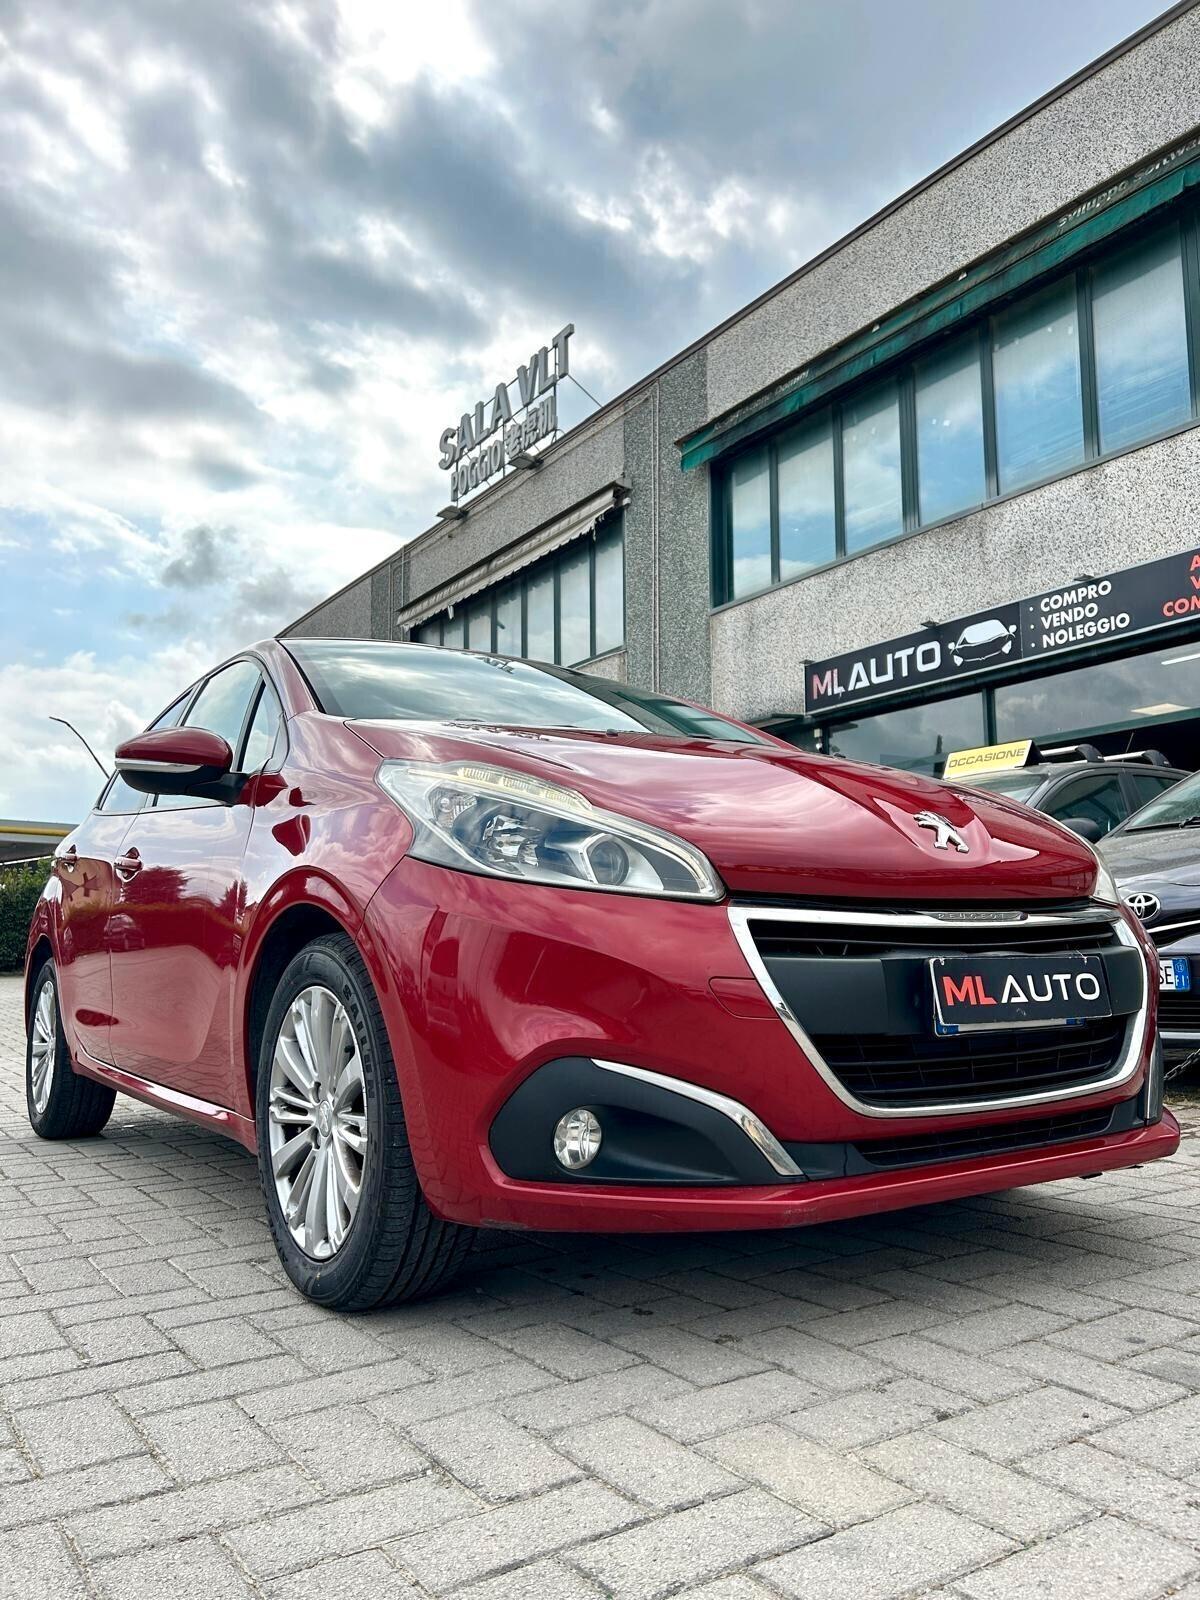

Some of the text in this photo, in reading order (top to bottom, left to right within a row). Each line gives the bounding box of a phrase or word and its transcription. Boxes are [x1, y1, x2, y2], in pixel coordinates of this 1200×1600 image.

[438, 323, 574, 470] SALA VLT
[451, 439, 504, 501] POGGIO
[1040, 580, 1112, 612] COMPRO
[1041, 603, 1099, 630] VENDO
[1042, 613, 1130, 648] NOLEGGIO
[948, 748, 1026, 768] OCCASIONE
[938, 912, 1005, 920] PEUGEOT
